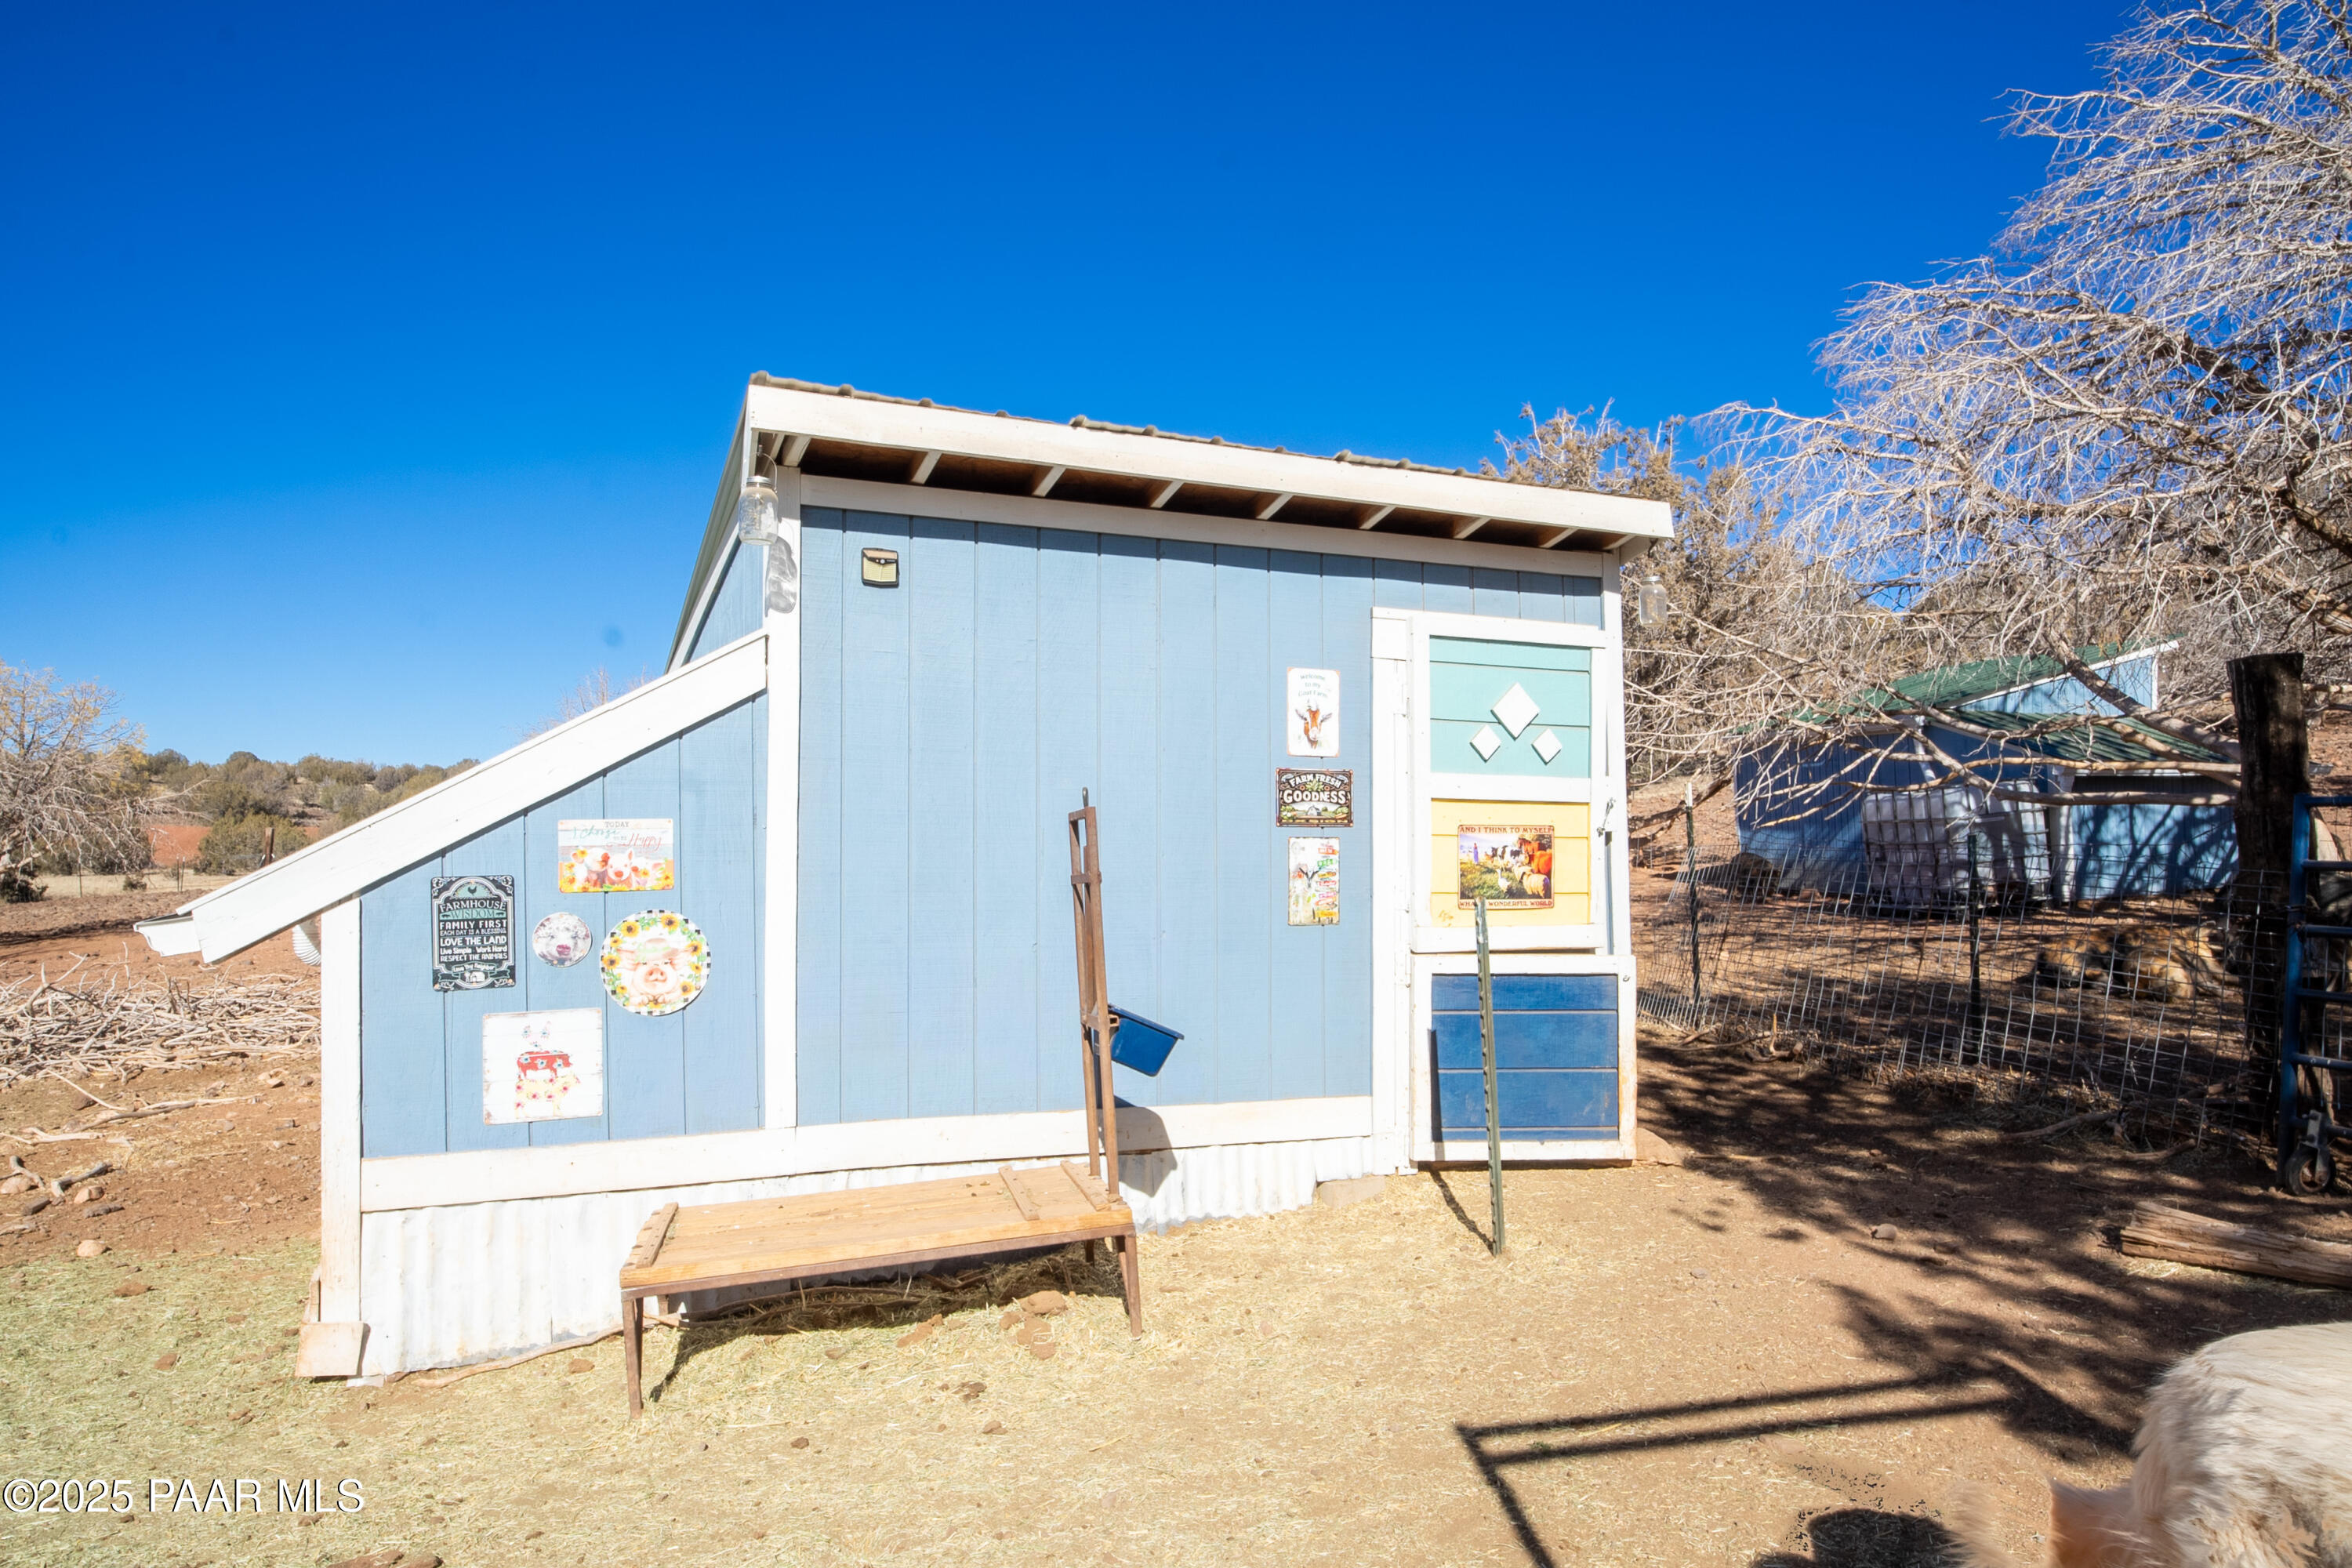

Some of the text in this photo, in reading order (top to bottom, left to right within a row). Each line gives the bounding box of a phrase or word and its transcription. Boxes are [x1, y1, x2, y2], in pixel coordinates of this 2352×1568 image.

[1289, 774, 1342, 788] FARM FRESH
[1283, 789, 1346, 804] GOODNESS
[440, 900, 506, 913] FARMHOUSE
[451, 909, 495, 919] WISDOM
[440, 920, 507, 930] FAMILY FIRST
[440, 935, 507, 947] LOVE THE LAND
[440, 947, 452, 956] Live
[452, 946, 472, 956] Simple
[475, 945, 492, 953] Work
